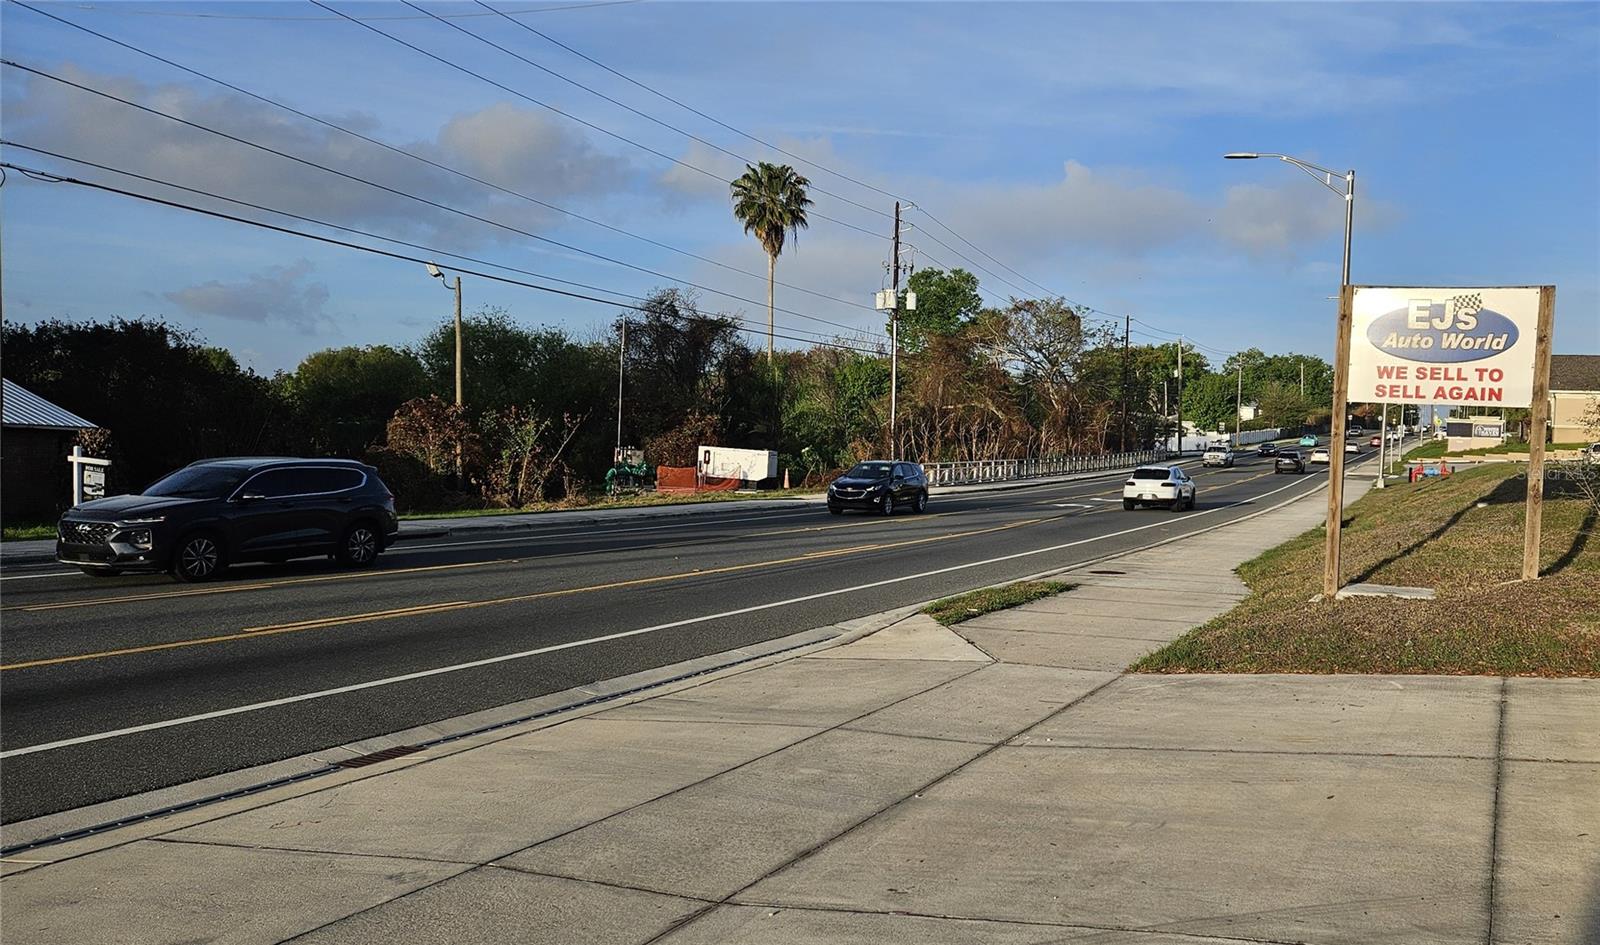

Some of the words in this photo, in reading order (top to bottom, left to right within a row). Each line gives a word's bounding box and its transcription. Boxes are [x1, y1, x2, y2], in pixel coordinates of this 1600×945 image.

[1381, 331, 1434, 349] Auto
[1440, 332, 1509, 351] World
[1376, 366, 1408, 380] WE
[1415, 366, 1469, 382] SELL
[1475, 368, 1504, 383] TO
[1374, 384, 1426, 399] SELL
[1433, 386, 1503, 402] AGAIN
